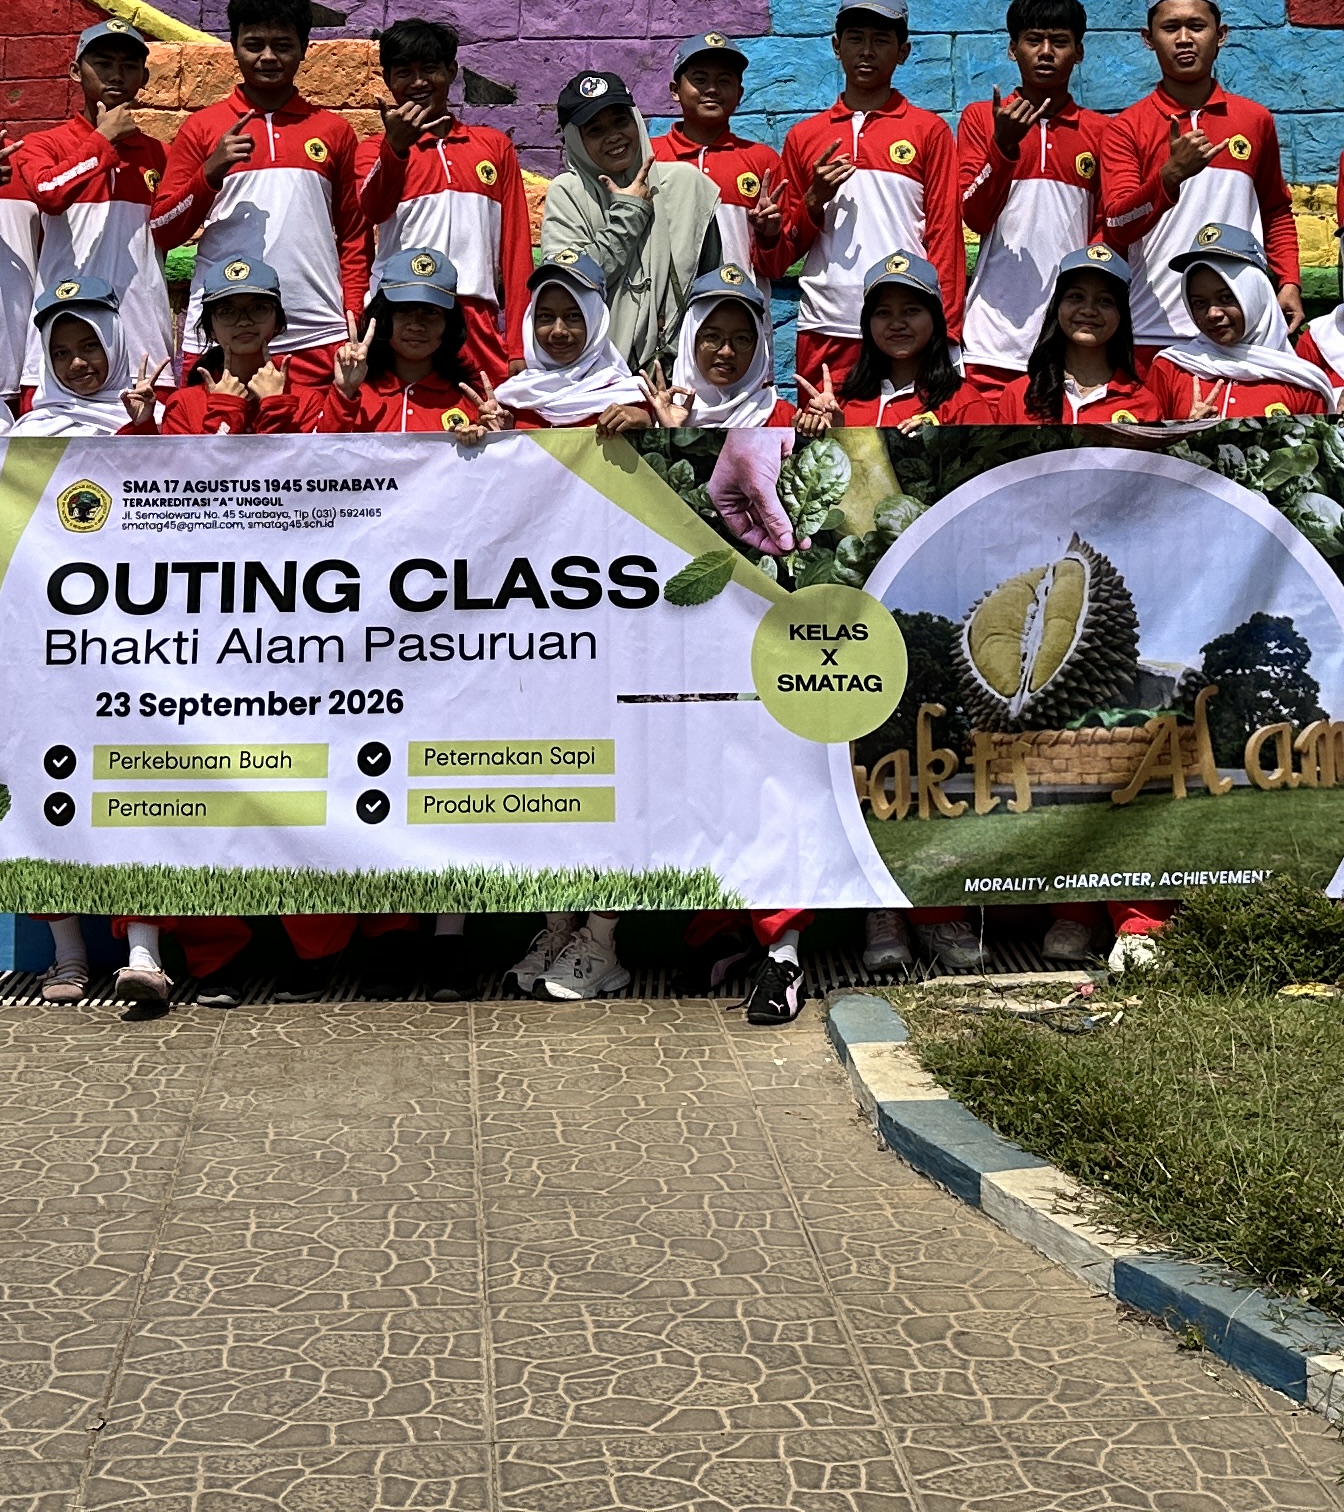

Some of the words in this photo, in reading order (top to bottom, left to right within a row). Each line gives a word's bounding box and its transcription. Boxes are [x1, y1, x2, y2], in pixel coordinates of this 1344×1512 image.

[122, 479, 160, 494] SMA
[163, 479, 180, 493] 17
[182, 479, 261, 493] AGUSTUS
[264, 478, 303, 493] 1945
[306, 477, 399, 492] SURABAYA
[122, 497, 211, 508] TERAKREDITASI
[236, 496, 284, 507] UNGGUL
[135, 510, 201, 520] Semolowaru
[203, 510, 220, 519] No.
[222, 509, 236, 519] 45
[238, 509, 291, 520] Surabaya,
[311, 507, 336, 520] (031)
[122, 519, 245, 532] smatag45@gmail.com,
[47, 560, 361, 616] OUTING
[390, 555, 660, 613] CLASS
[789, 623, 869, 641] KELAS
[45, 628, 199, 666] Bhakti
[216, 627, 344, 664] Alam
[365, 626, 597, 663] Pasuruan
[820, 648, 839, 666] X
[777, 674, 883, 693] SMATAG
[96, 691, 131, 718] 23
[139, 690, 322, 726] September
[328, 688, 404, 715] 2026
[109, 750, 231, 770] Perkebunan
[239, 749, 292, 769] Buah
[424, 746, 543, 767] Peternakan
[549, 745, 595, 770] Sapi
[853, 702, 1033, 821] akti
[108, 798, 207, 817] Pertanian
[424, 793, 496, 814] Produk
[502, 793, 581, 813] Olahan
[964, 876, 1050, 892] MORALITY,
[1053, 871, 1155, 889] CHARACTER,
